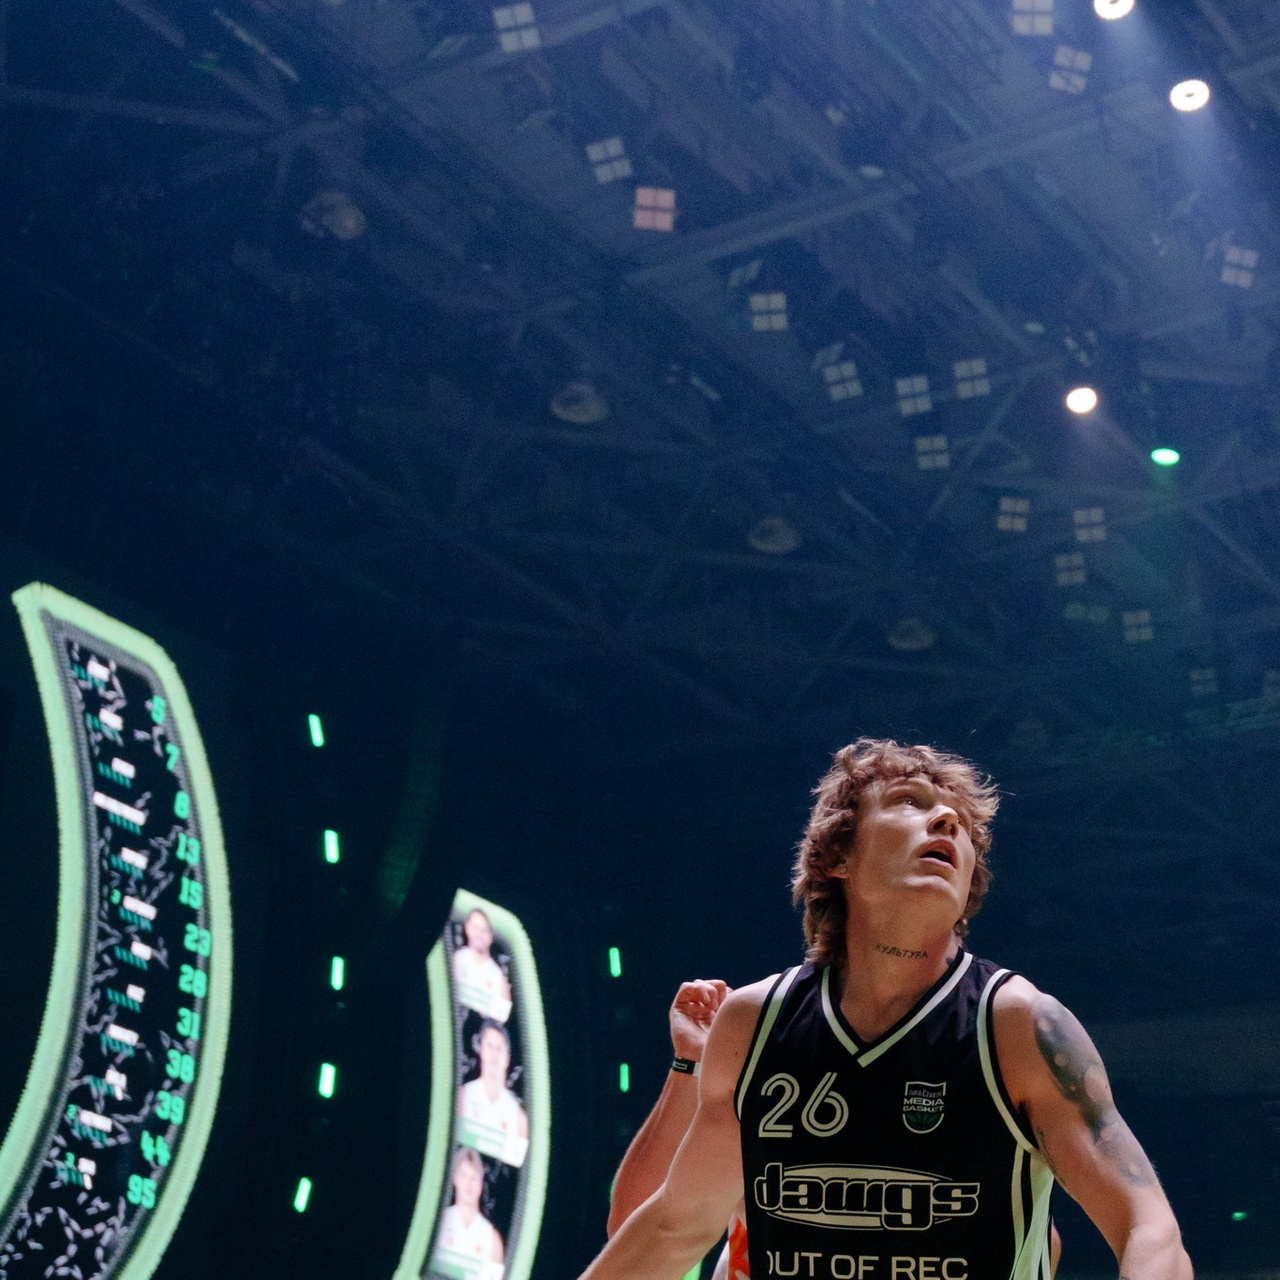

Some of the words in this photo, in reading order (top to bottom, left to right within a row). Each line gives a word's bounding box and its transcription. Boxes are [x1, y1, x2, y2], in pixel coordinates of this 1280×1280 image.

[165, 742, 179, 772] 7
[175, 1007, 200, 1042] 31
[155, 1090, 186, 1126] 39
[758, 1072, 850, 1138] 26
[903, 1097, 945, 1106] MEDIA
[140, 1129, 172, 1167] 44
[127, 1174, 157, 1209] 95
[754, 1162, 981, 1231] dawgs
[830, 1254, 879, 1280] OF
